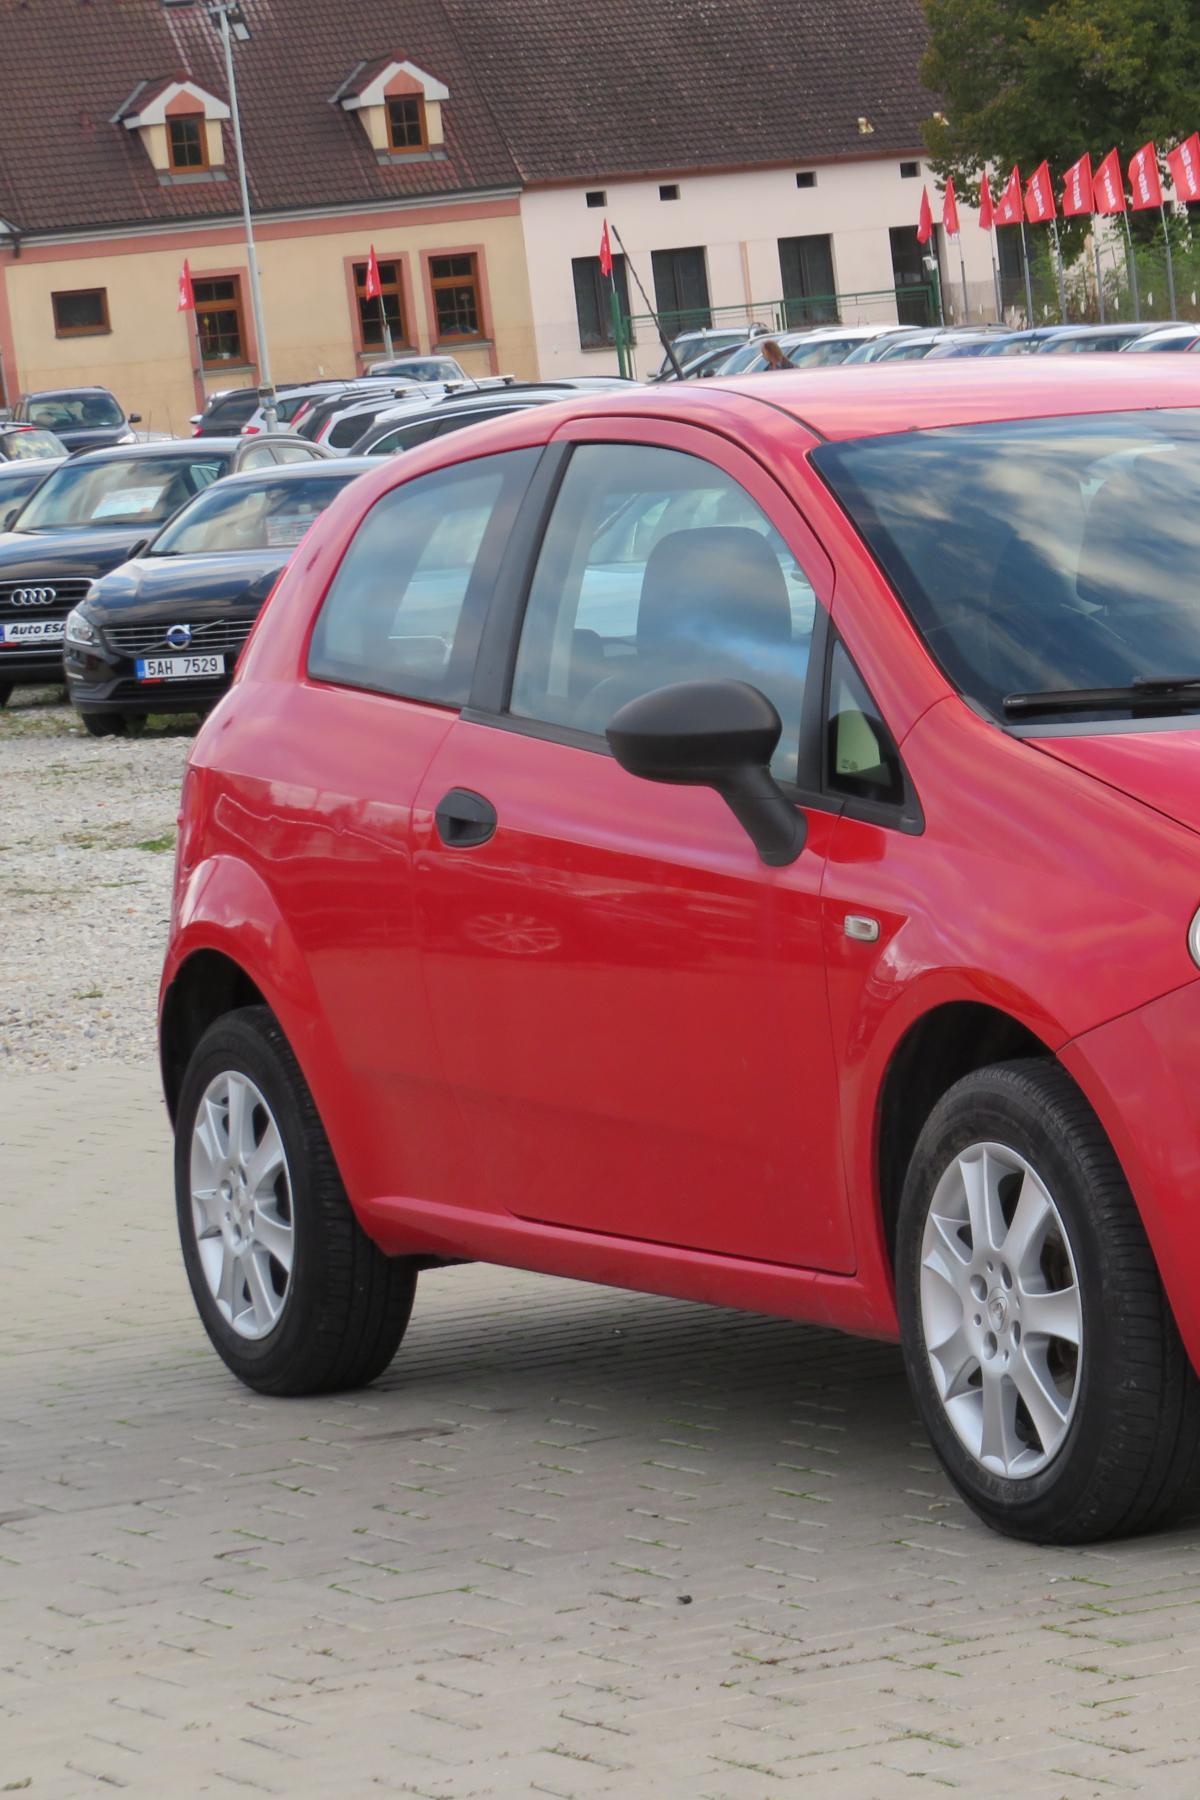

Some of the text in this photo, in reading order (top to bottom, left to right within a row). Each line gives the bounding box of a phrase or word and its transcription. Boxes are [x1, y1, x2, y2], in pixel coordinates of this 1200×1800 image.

[10, 624, 42, 635] Auto
[147, 657, 218, 676] 5AH 7529
